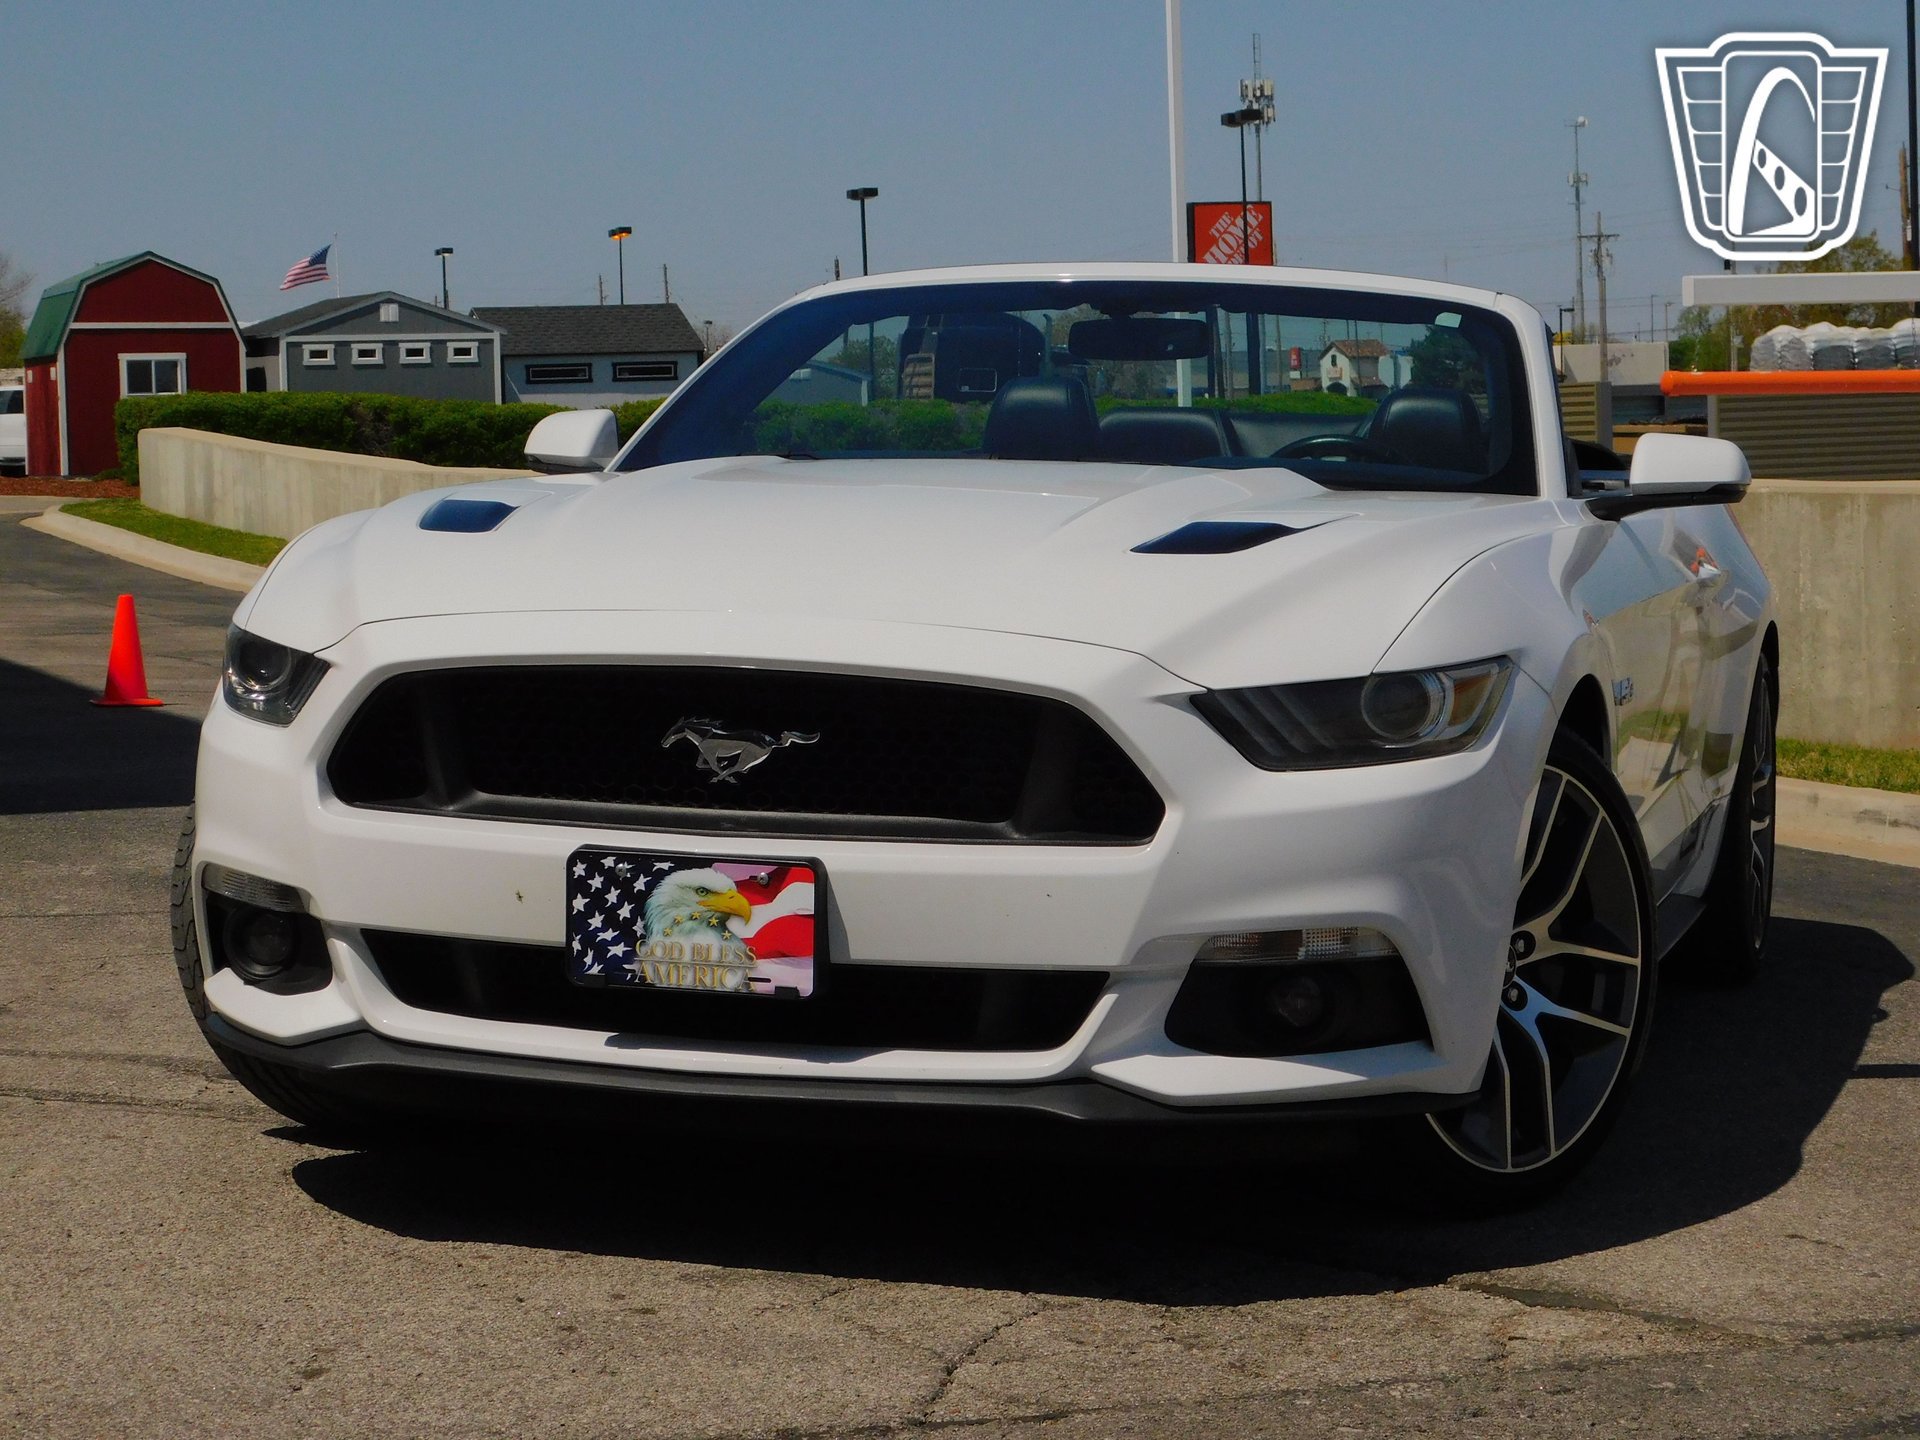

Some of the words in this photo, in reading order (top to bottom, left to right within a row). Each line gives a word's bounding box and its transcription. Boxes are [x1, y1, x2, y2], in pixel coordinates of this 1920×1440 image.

[1202, 204, 1264, 264] HOME
[1209, 211, 1233, 239] THE
[635, 938, 686, 961] GOD
[691, 942, 758, 965] BLESS
[633, 960, 757, 992] AMERICA
